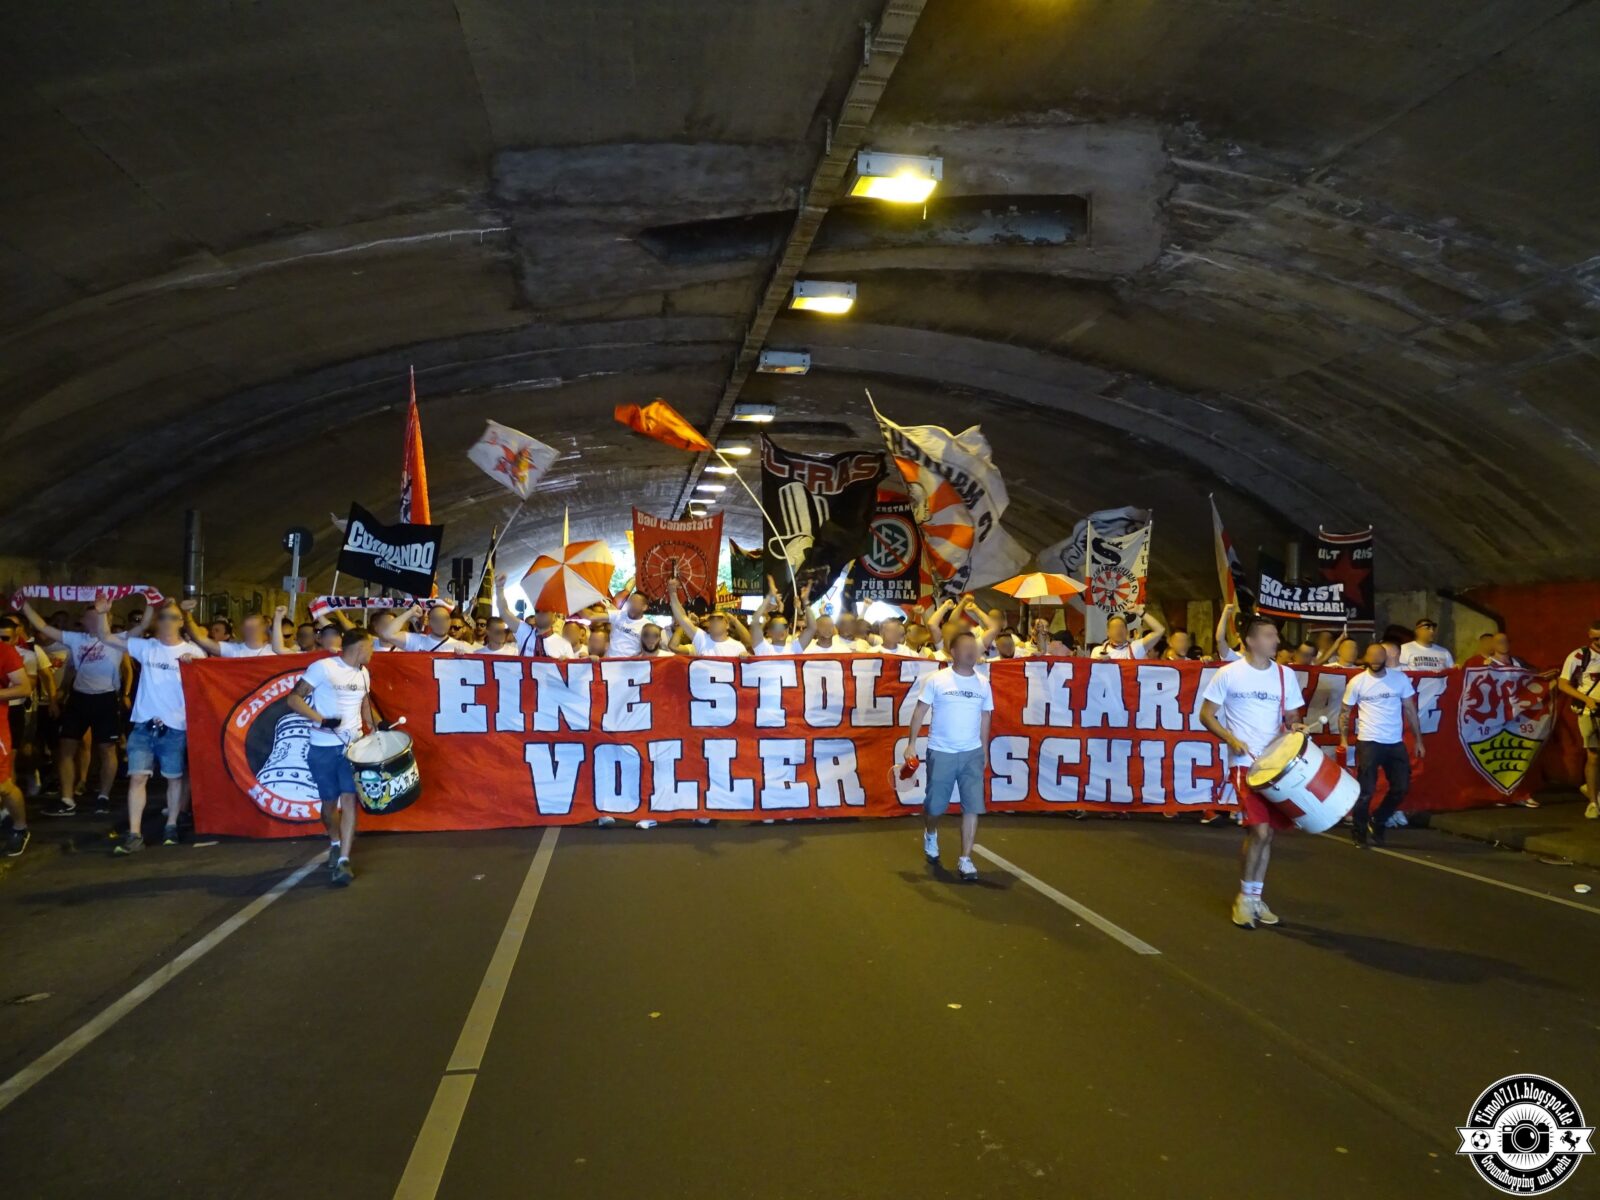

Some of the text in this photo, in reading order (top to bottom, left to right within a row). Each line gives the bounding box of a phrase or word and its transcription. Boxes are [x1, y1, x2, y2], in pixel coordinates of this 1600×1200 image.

[761, 436, 881, 495] LTRAS
[637, 511, 714, 531] Bad Cannstatt
[855, 590, 917, 600] FUSSBALL
[861, 578, 912, 590] FÜR DEN
[1260, 573, 1344, 601] 50+1 IST
[1260, 593, 1344, 613] UNANTASTBAR!
[235, 674, 302, 728] CANN
[433, 658, 1449, 736] EINE STOLZ KARAE
[1477, 723, 1535, 736] 18 93
[524, 738, 867, 814] VOLLER
